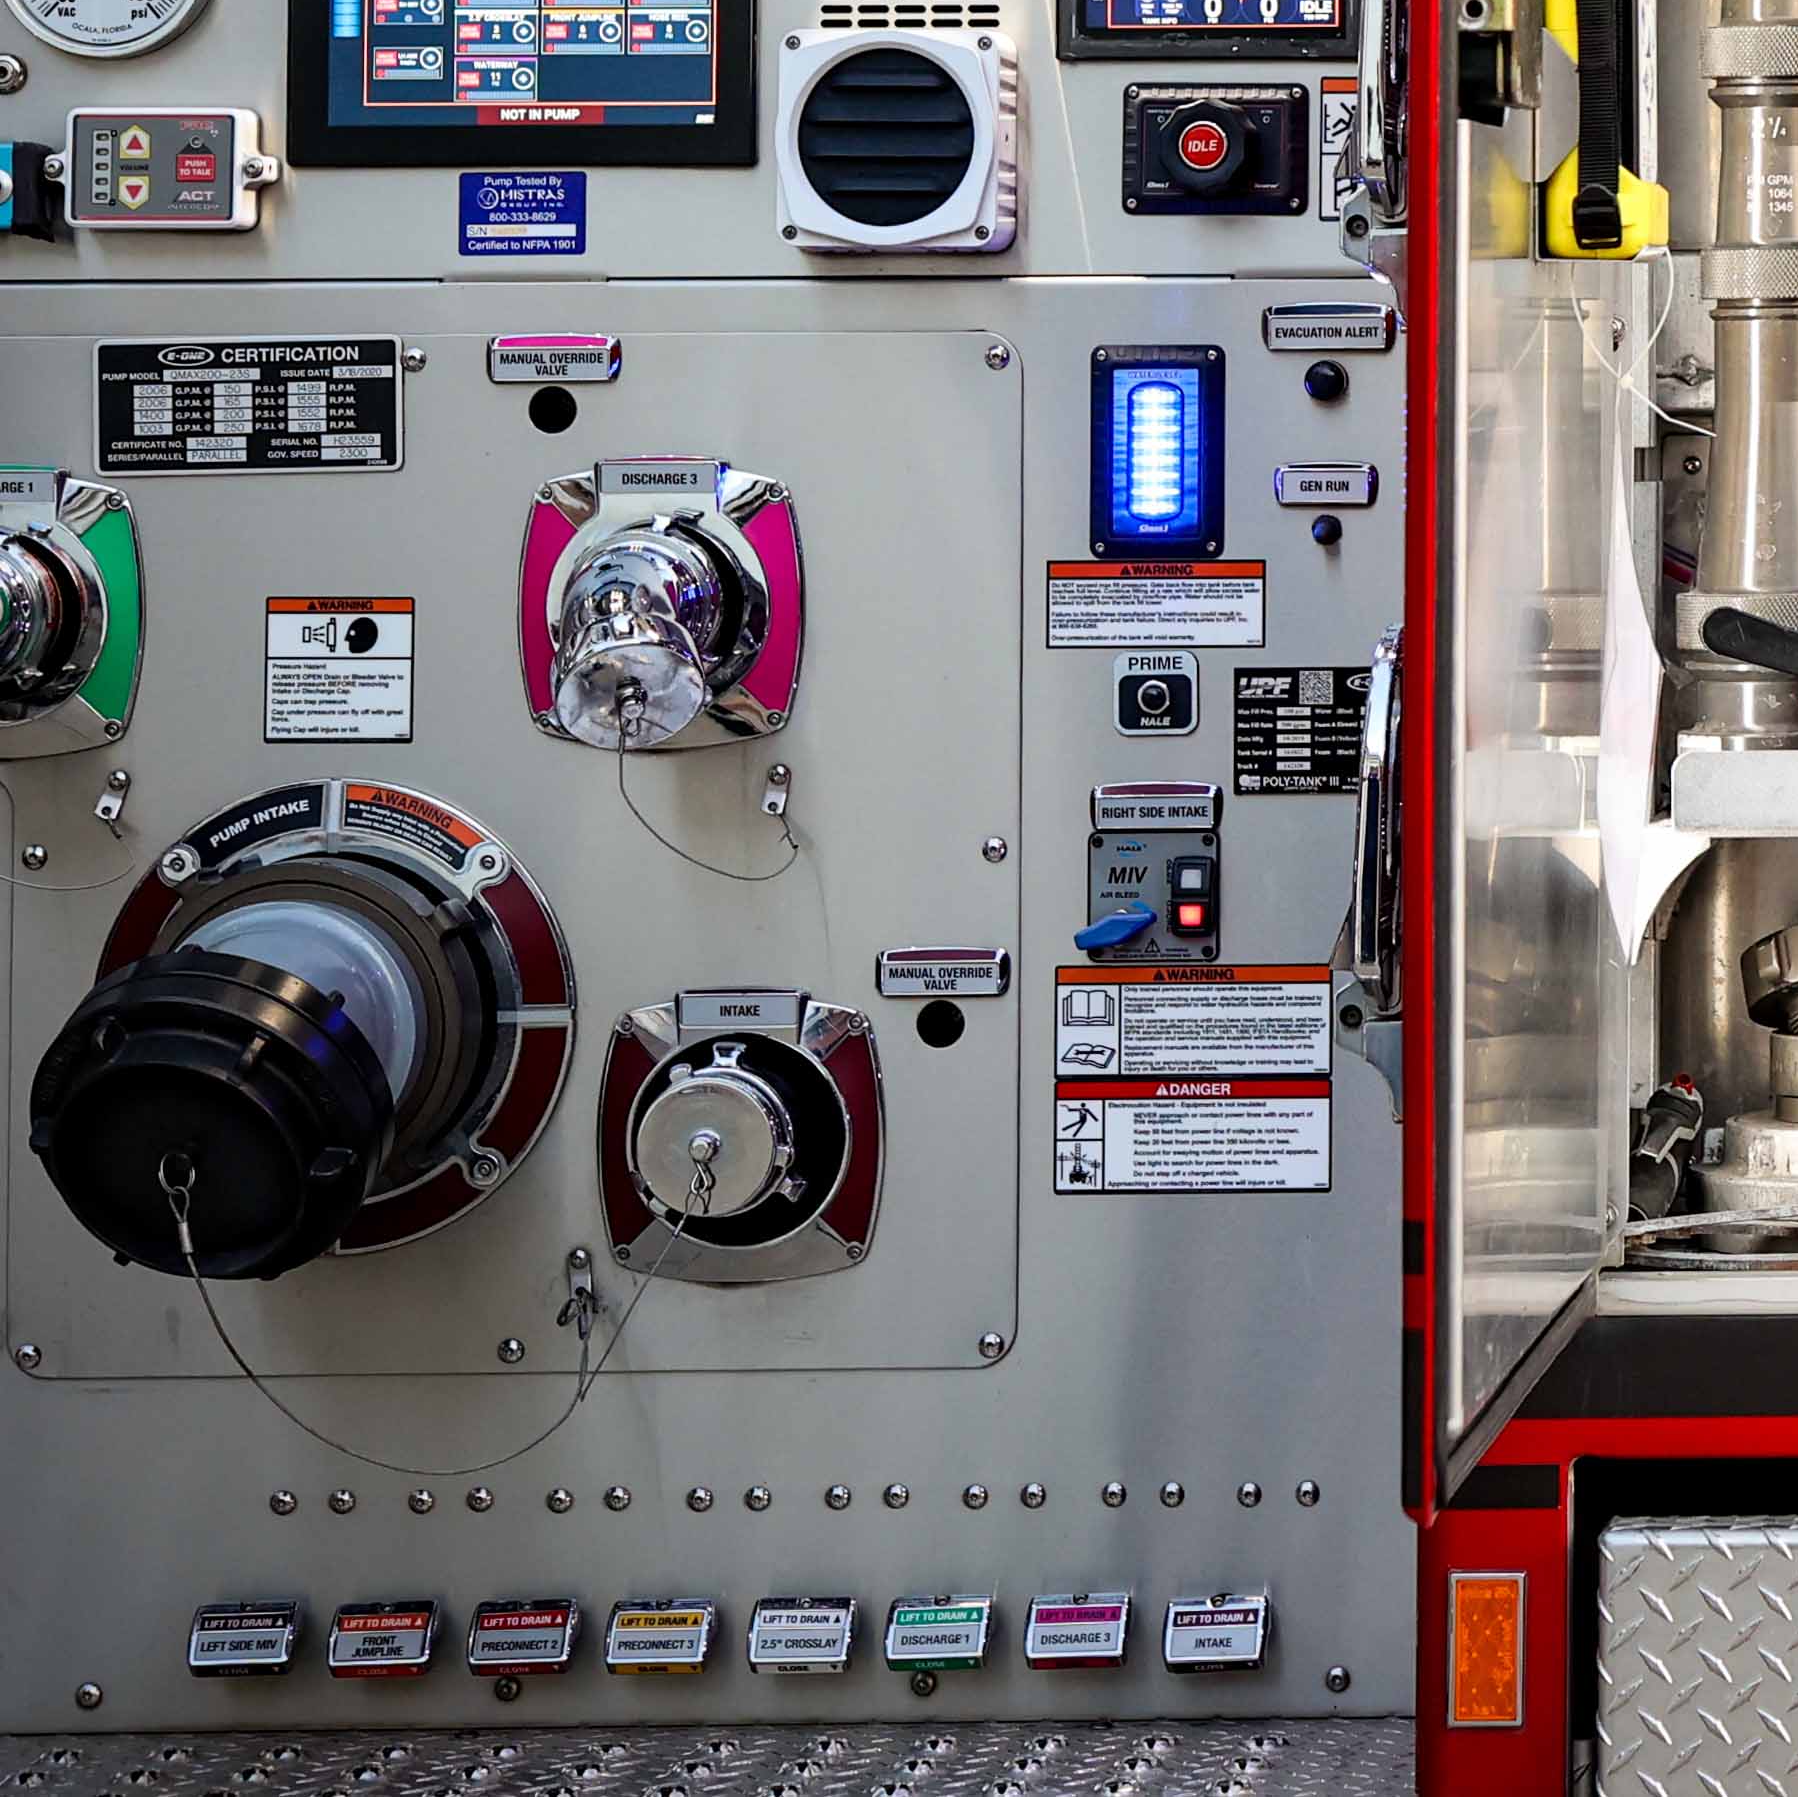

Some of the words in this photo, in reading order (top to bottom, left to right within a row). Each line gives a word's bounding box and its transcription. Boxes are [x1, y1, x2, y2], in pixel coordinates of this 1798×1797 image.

[58, 8, 75, 17] VAC
[131, 8, 147, 20] psi
[102, 24, 133, 33] FLORIDA
[500, 109, 525, 120] NOT
[529, 109, 541, 120] IN
[544, 109, 580, 120] PUMP
[1188, 140, 1217, 152] IDLE
[484, 177, 512, 187] Pump
[516, 177, 546, 186] Tested
[549, 177, 562, 187] By
[1768, 176, 1794, 185] GPM
[179, 191, 215, 200] ACT
[501, 189, 565, 200] MISTRAS
[1769, 189, 1793, 199] 1064
[1769, 202, 1793, 211] 1345
[489, 212, 556, 221] 800-333-8629
[468, 241, 508, 250] Certified
[511, 241, 520, 249] to
[523, 240, 550, 249] NFPA
[554, 240, 575, 249] 1901
[1275, 327, 1342, 338] EVACUATION
[1346, 327, 1379, 337] ALERT
[221, 346, 359, 363] CERTIFICATION
[500, 354, 546, 364] MANUAL
[550, 353, 603, 363] OVERRIDE
[535, 366, 568, 375] VALVE
[130, 372, 160, 380] MODEL
[108, 453, 184, 461] SERIES/PARALLEL
[291, 450, 318, 458] SPEED
[622, 474, 685, 484] DISCHARGE
[690, 474, 697, 484] 3
[1300, 482, 1321, 491] GEN
[1326, 482, 1349, 491] RUN
[1133, 566, 1193, 575] WARNING
[320, 601, 373, 610] WARNING
[1129, 657, 1182, 670] PRIME
[1239, 677, 1292, 695] UPF
[1141, 717, 1171, 726] HALE
[1330, 776, 1339, 786] III
[386, 791, 453, 828] WARNING
[1102, 808, 1136, 818] RIGHT
[1139, 807, 1165, 817] SIDE
[1169, 807, 1208, 817] INTAKE
[209, 819, 250, 847] PUMP
[253, 800, 310, 825] INTAKE
[1108, 866, 1148, 884] MIV
[889, 969, 935, 978] MANUAL
[938, 968, 993, 978] OVERRIDE
[1167, 969, 1234, 981] WARNING
[924, 980, 957, 990] VALVE
[720, 1005, 760, 1017] INTAKE
[1170, 1084, 1231, 1095] DANGER
[763, 1615, 783, 1624] LIFT
[785, 1616, 797, 1624] TO
[800, 1615, 829, 1624] DRAIN
[1177, 1615, 1198, 1624] LIFT
[1200, 1615, 1211, 1623] TO
[1213, 1614, 1244, 1622] DRAIN
[362, 1637, 397, 1645] FRONT
[785, 1639, 838, 1649] CROSSLAY
[901, 1635, 961, 1645] DISCHARGE
[965, 1635, 970, 1643] 1
[1041, 1633, 1101, 1645] DISCHARGE
[1104, 1633, 1111, 1643] 3
[1195, 1638, 1232, 1648] INTAKE
[200, 1642, 226, 1652] LEFT
[229, 1641, 253, 1650] SIDE
[256, 1640, 277, 1649] MIV
[481, 1641, 548, 1651] PRECONNECT
[551, 1641, 558, 1649] 2
[617, 1641, 684, 1650] PRECONNECT
[687, 1641, 693, 1649] 3
[352, 1647, 404, 1657] JUMPLINE
